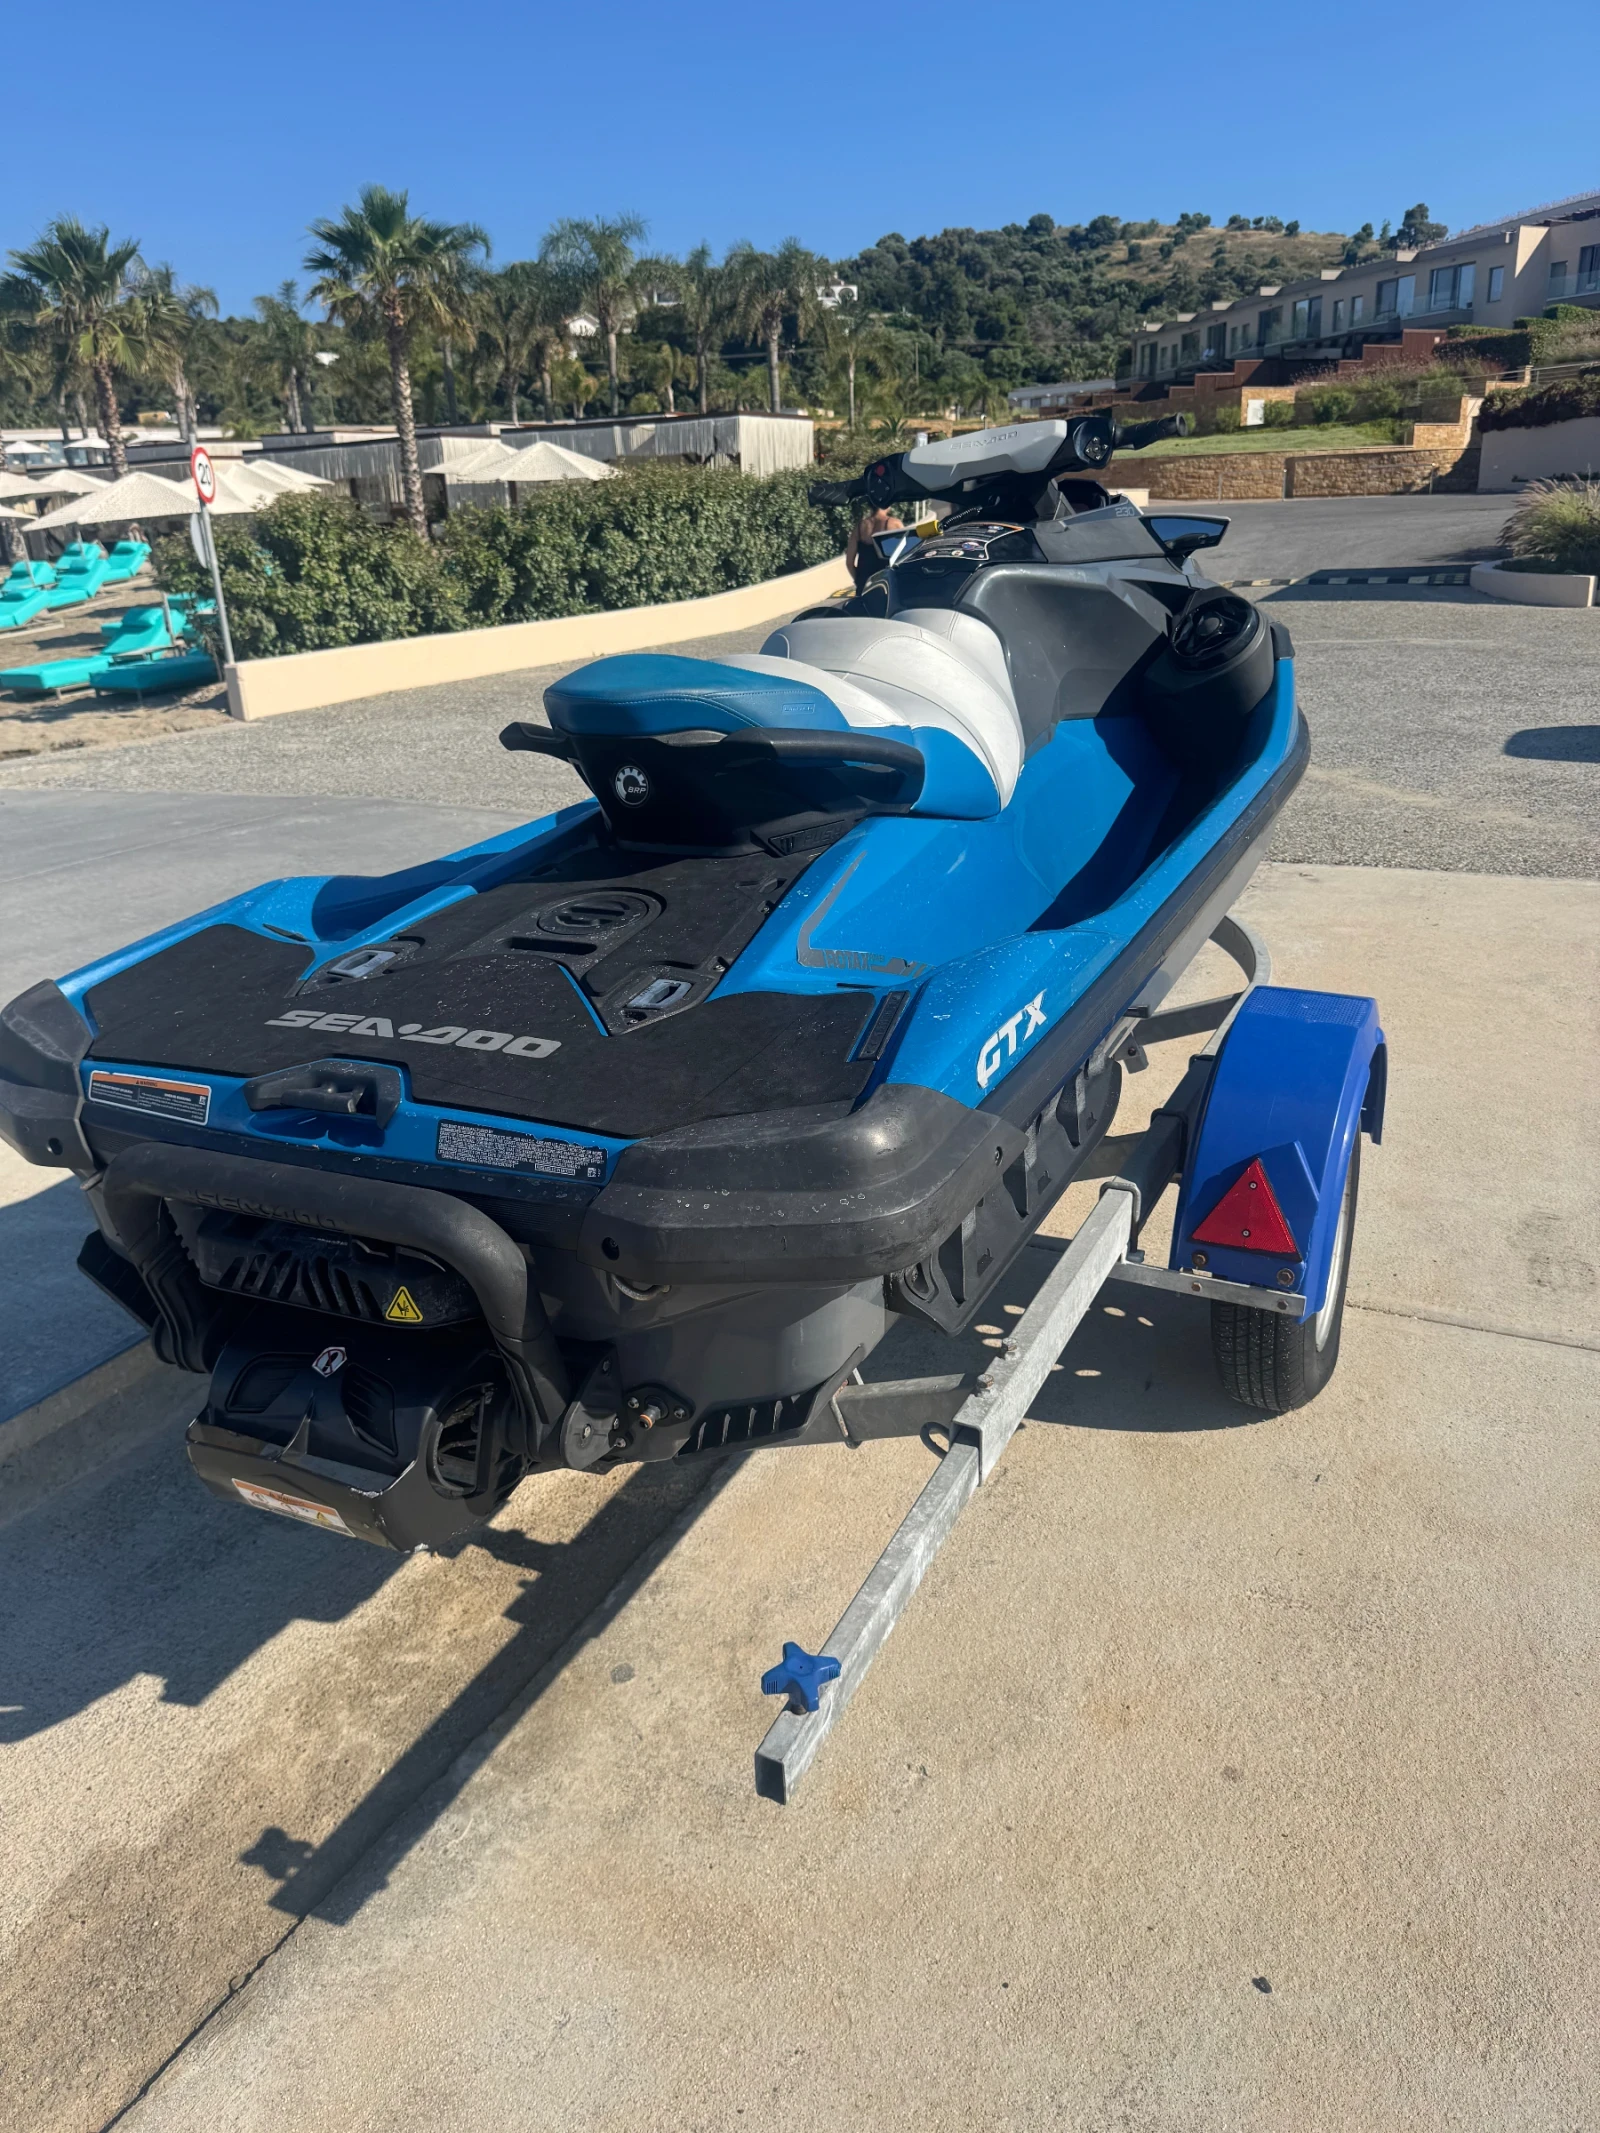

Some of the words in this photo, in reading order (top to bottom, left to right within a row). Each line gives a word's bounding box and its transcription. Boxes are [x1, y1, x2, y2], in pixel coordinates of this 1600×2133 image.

[198, 463, 211, 486] 20
[1115, 506, 1135, 517] 230
[627, 786, 647, 794] BRP
[976, 988, 1048, 1089] GTX
